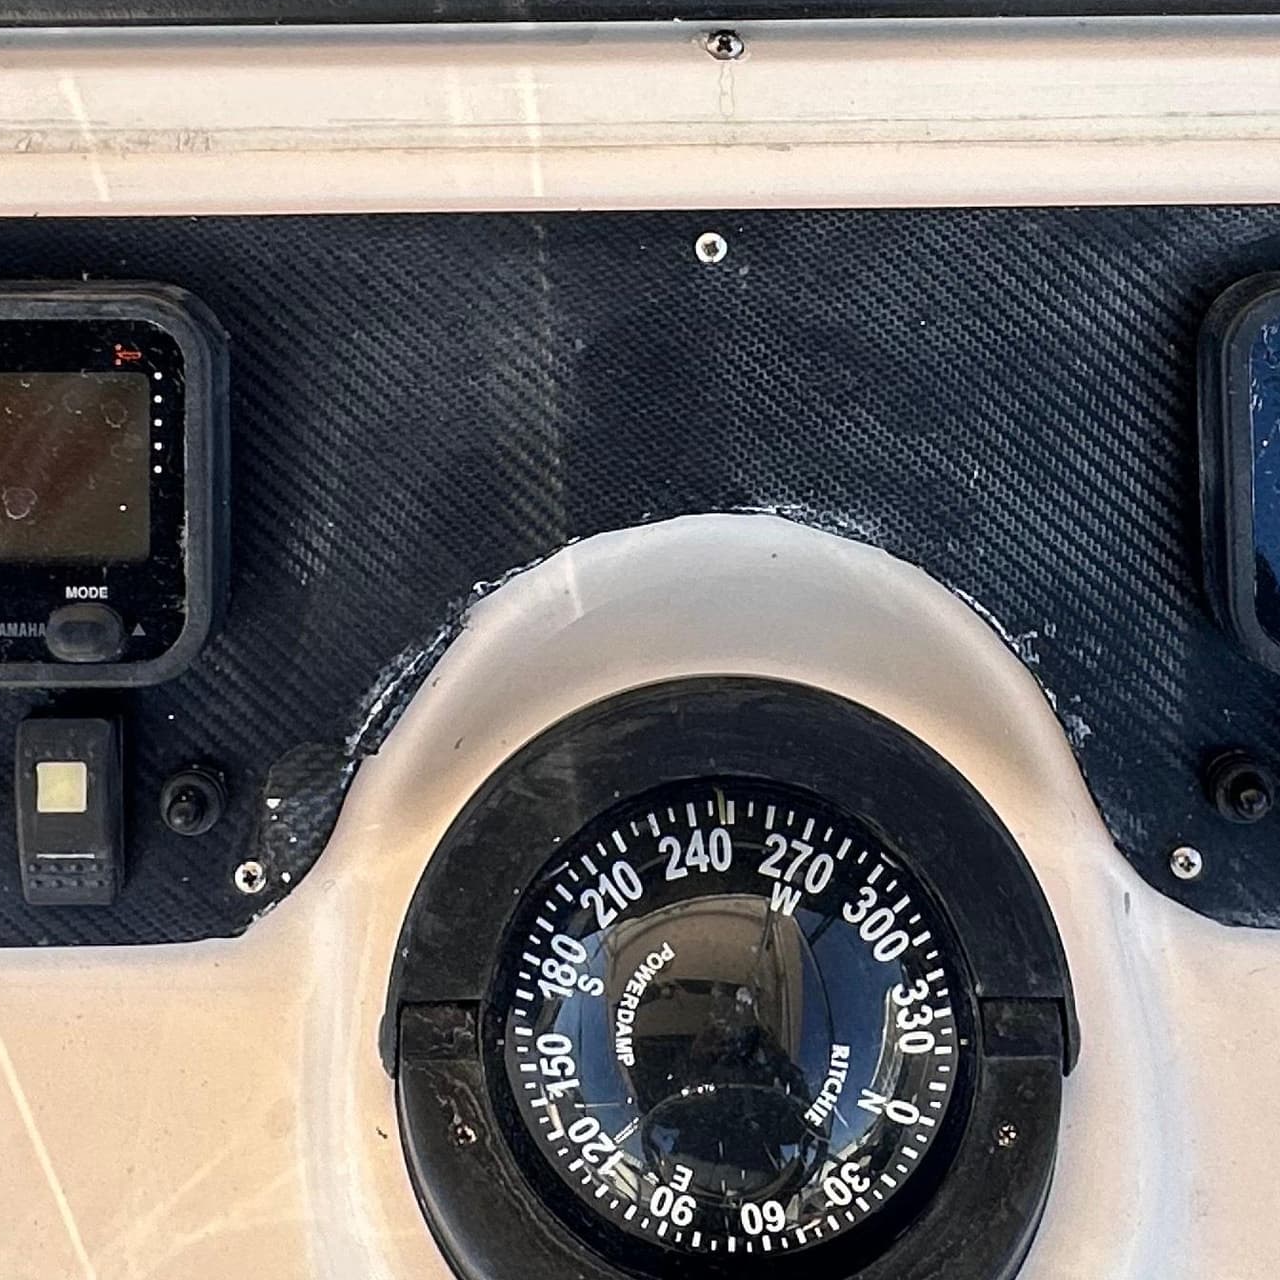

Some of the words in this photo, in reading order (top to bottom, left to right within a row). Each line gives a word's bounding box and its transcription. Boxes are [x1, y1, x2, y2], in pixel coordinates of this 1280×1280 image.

[65, 585, 109, 599] MODE
[659, 828, 732, 879] 240
[759, 834, 834, 894] 270
[580, 860, 644, 929] 210
[770, 881, 802, 916] W
[842, 886, 910, 963] 300
[537, 934, 588, 1001] 180
[577, 973, 604, 997] S
[615, 941, 676, 1067] POWERDAMP
[891, 980, 936, 1054] 330
[537, 1032, 580, 1099] 150
[804, 1044, 850, 1126] RITCHIE
[857, 1088, 888, 1115] N
[886, 1100, 920, 1125] 0
[567, 1115, 626, 1178] 120
[668, 1163, 694, 1193] E
[823, 1162, 871, 1206] 30
[649, 1184, 698, 1228] 90
[740, 1201, 786, 1235] 60
